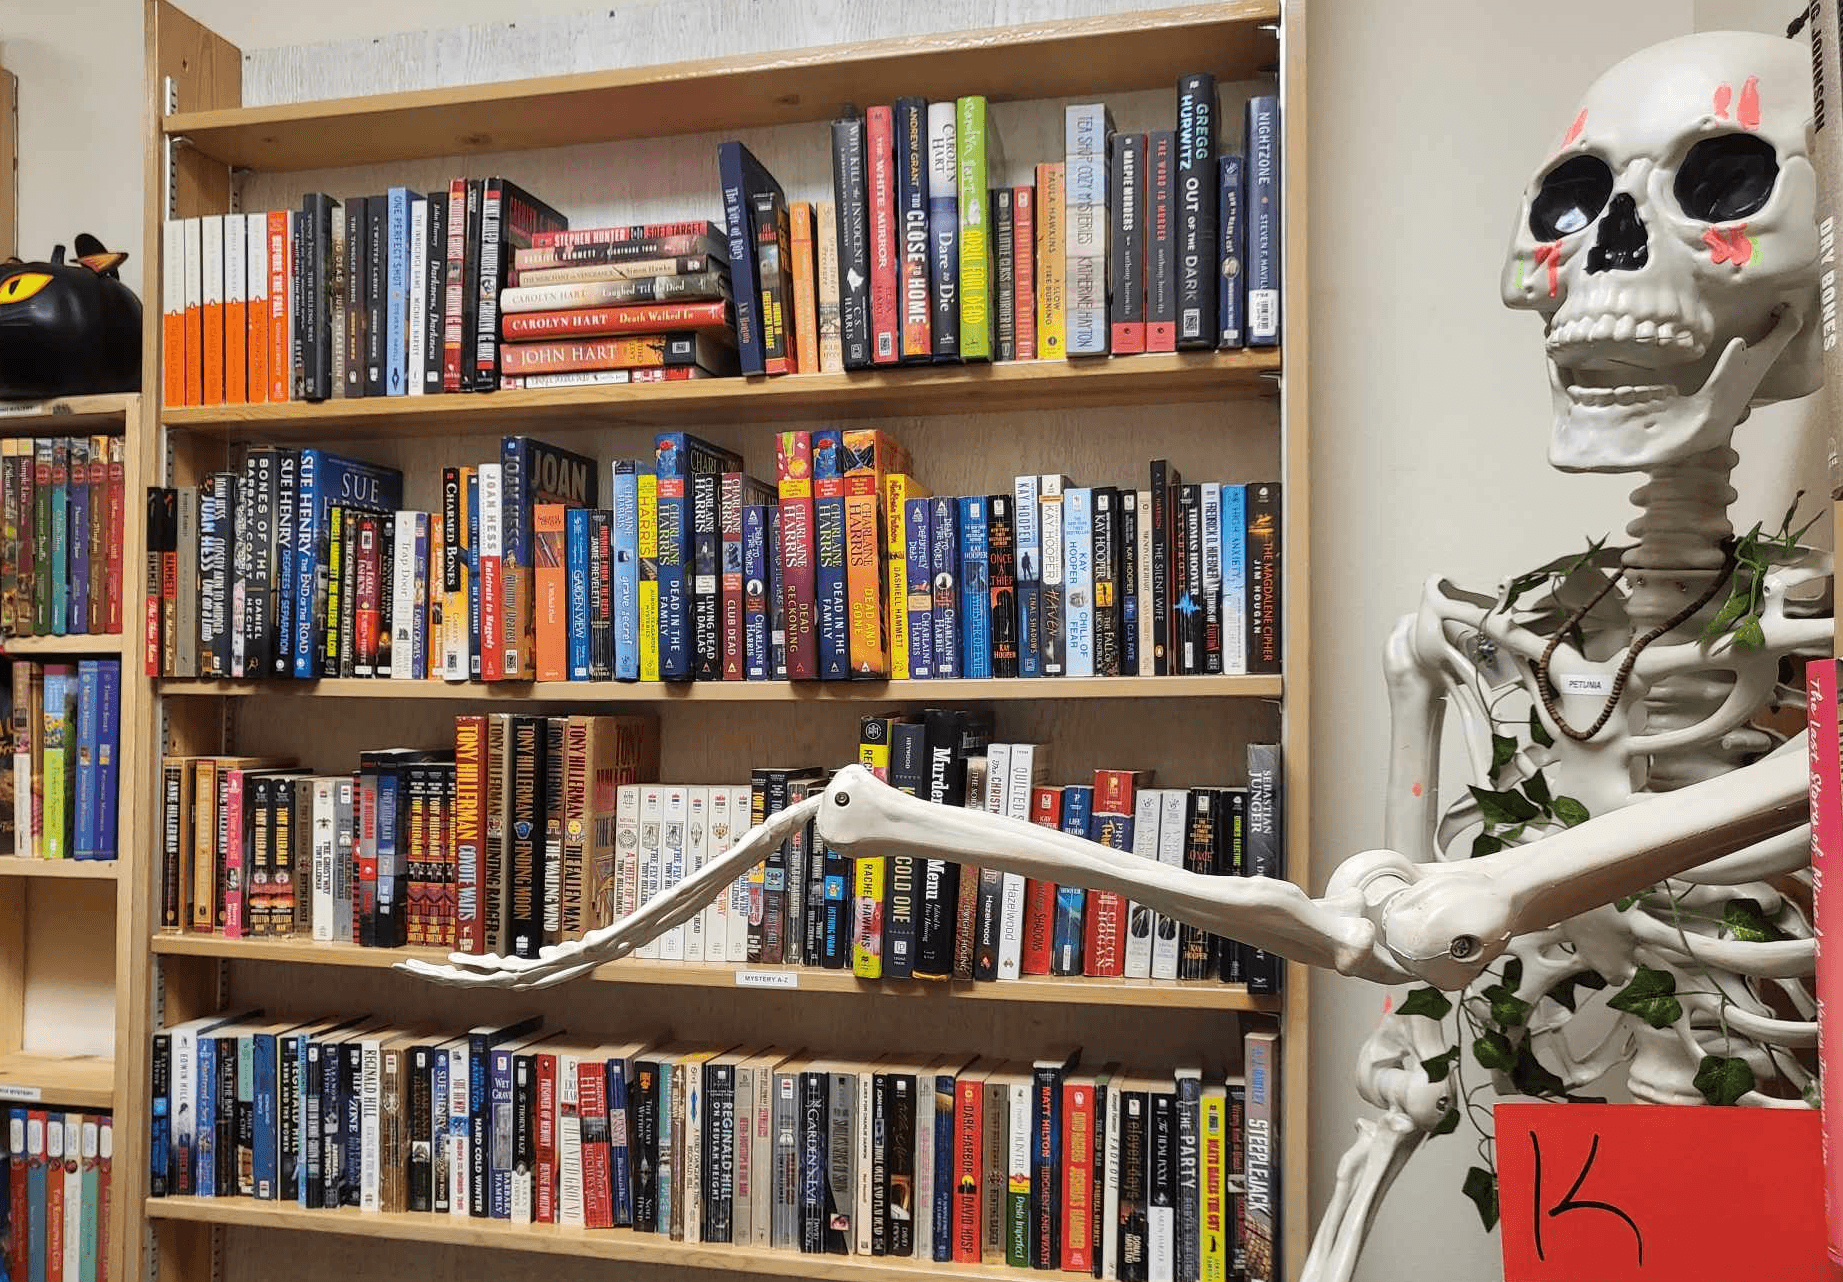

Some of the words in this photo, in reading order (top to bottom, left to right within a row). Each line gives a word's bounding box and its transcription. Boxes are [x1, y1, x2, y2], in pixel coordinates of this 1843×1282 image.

[1812, 29, 1824, 133] JOHNSON
[849, 124, 860, 154] WHY
[909, 106, 919, 150] ANDREW
[1179, 94, 1192, 171] HURWITZ
[1195, 103, 1208, 160] GREGG
[1258, 111, 1271, 186] NIGHTZONE
[849, 156, 861, 185] KILL
[876, 159, 886, 206] WHITE
[910, 153, 919, 187] GRANT
[911, 192, 921, 208] TOO
[1186, 177, 1199, 212] OUT
[851, 202, 863, 264] INNOCENT
[877, 211, 887, 270] MIRROR
[906, 210, 926, 263] CLOSE
[1187, 216, 1196, 230] OF
[1187, 231, 1197, 251] THE
[1259, 213, 1268, 247] STEVEN
[1820, 216, 1835, 263] DRY
[938, 230, 954, 269] Dare
[939, 283, 954, 312] Die
[1184, 255, 1197, 301] DARK
[620, 313, 646, 325] Death
[647, 311, 679, 323] Walked
[907, 277, 926, 324] HOME
[1820, 270, 1836, 351] BONES
[513, 316, 569, 331] CAROLYN
[573, 314, 608, 327] HART
[521, 348, 564, 366] JOHN
[573, 344, 617, 362] HART
[257, 458, 268, 514] BONES
[280, 458, 293, 488] SUE
[300, 455, 313, 488] SUE
[341, 472, 380, 503] SUE
[531, 449, 587, 502] JOAN
[247, 458, 256, 526] BARBARY
[695, 477, 706, 533] HARRIS
[721, 480, 732, 533] HARRIS
[278, 491, 293, 548] HENRY
[298, 493, 313, 557] HENRY
[446, 482, 457, 542] CHARMED
[1095, 515, 1106, 536] KAY
[1189, 507, 1199, 550] THOMAS
[257, 521, 267, 543] OF
[659, 504, 670, 566] HARRIS
[784, 504, 797, 568] HARRIS
[819, 505, 831, 567] HARRIS
[849, 504, 863, 567] HARRIS
[861, 502, 873, 566] CHARLAINE
[245, 532, 253, 580] COAST
[256, 549, 267, 580] THE
[281, 550, 292, 590] DEGREES
[446, 546, 457, 585] BONES
[1069, 541, 1078, 584] HOOPER
[1079, 552, 1089, 572] KAY
[1095, 537, 1106, 579] HOOPER
[1189, 551, 1200, 596] HOOVER
[300, 574, 310, 597] END
[669, 580, 680, 611] DEAD
[833, 582, 843, 613] DEAD
[894, 566, 902, 605] DASHIELL
[254, 598, 262, 639] DANIEL
[280, 599, 291, 655] SEPARATION
[659, 596, 669, 636] FAMILY
[669, 614, 680, 627] IN
[706, 595, 715, 630] LIVING
[727, 599, 736, 626] CLUB
[787, 585, 797, 653] RECKONING
[799, 603, 809, 633] DEAD
[822, 599, 833, 639] FAMILY
[834, 615, 844, 629] IN
[853, 602, 864, 635] GONE
[895, 608, 903, 648] HAMMETT
[299, 622, 310, 654] ROAD
[670, 629, 680, 652] THE
[706, 632, 715, 660] DEAD
[727, 629, 736, 655] DEAD
[834, 632, 844, 655] THE
[1029, 618, 1037, 654] SHADOWS
[1069, 621, 1078, 648] FEAR
[1568, 680, 1602, 689] PETUNIA
[1810, 679, 1824, 713] The
[456, 723, 478, 761] TONY
[515, 723, 535, 752] TONY
[567, 724, 587, 754] TONY
[456, 763, 478, 840] HILLERMAN
[515, 754, 535, 819] HILLERMAN
[567, 756, 587, 819] HILLERMAN
[1249, 771, 1262, 833] JUNGER
[1261, 770, 1272, 834] SEBASTIAN
[1810, 772, 1822, 826] Story
[514, 840, 532, 884] FINDING
[564, 844, 583, 863] THE
[1811, 833, 1824, 857] of
[457, 845, 476, 886] COYOTE
[564, 865, 583, 902] FALLEN
[863, 863, 873, 899] RACHEL
[893, 856, 913, 888] COLD
[925, 860, 945, 900] Menu
[457, 887, 476, 920] WAITS
[514, 886, 532, 920] MOON
[563, 905, 581, 932] MAN
[892, 895, 912, 923] ONE
[981, 894, 992, 945] Hazelwood
[1003, 882, 1019, 941] Hazelwood
[861, 904, 872, 947] HAWKINS
[744, 975, 776, 983] MYSTERY
[363, 1050, 377, 1094] REGINALD
[471, 1057, 479, 1112] HAMILTON
[363, 1096, 376, 1118] HILL
[580, 1076, 597, 1116] HILL
[474, 1118, 482, 1145] HARD
[722, 1102, 733, 1170] REGINALD
[962, 1105, 974, 1131] DARK
[1180, 1111, 1189, 1129] THE
[324, 1136, 332, 1187] INSTINCTS
[474, 1147, 482, 1172] COLD
[962, 1134, 974, 1174] HARBOR
[1180, 1135, 1196, 1189] PARTY
[1247, 1119, 1270, 1212] STEEPLEJACK
[474, 1174, 482, 1212] WINTER
[494, 1173, 502, 1213] HAMBLY
[721, 1173, 732, 1200] HILL
[1528, 1128, 1644, 1268] K
[962, 1196, 974, 1225] DAVID
[962, 1228, 973, 1254] HOSP
[1133, 1235, 1141, 1262] DONALD
